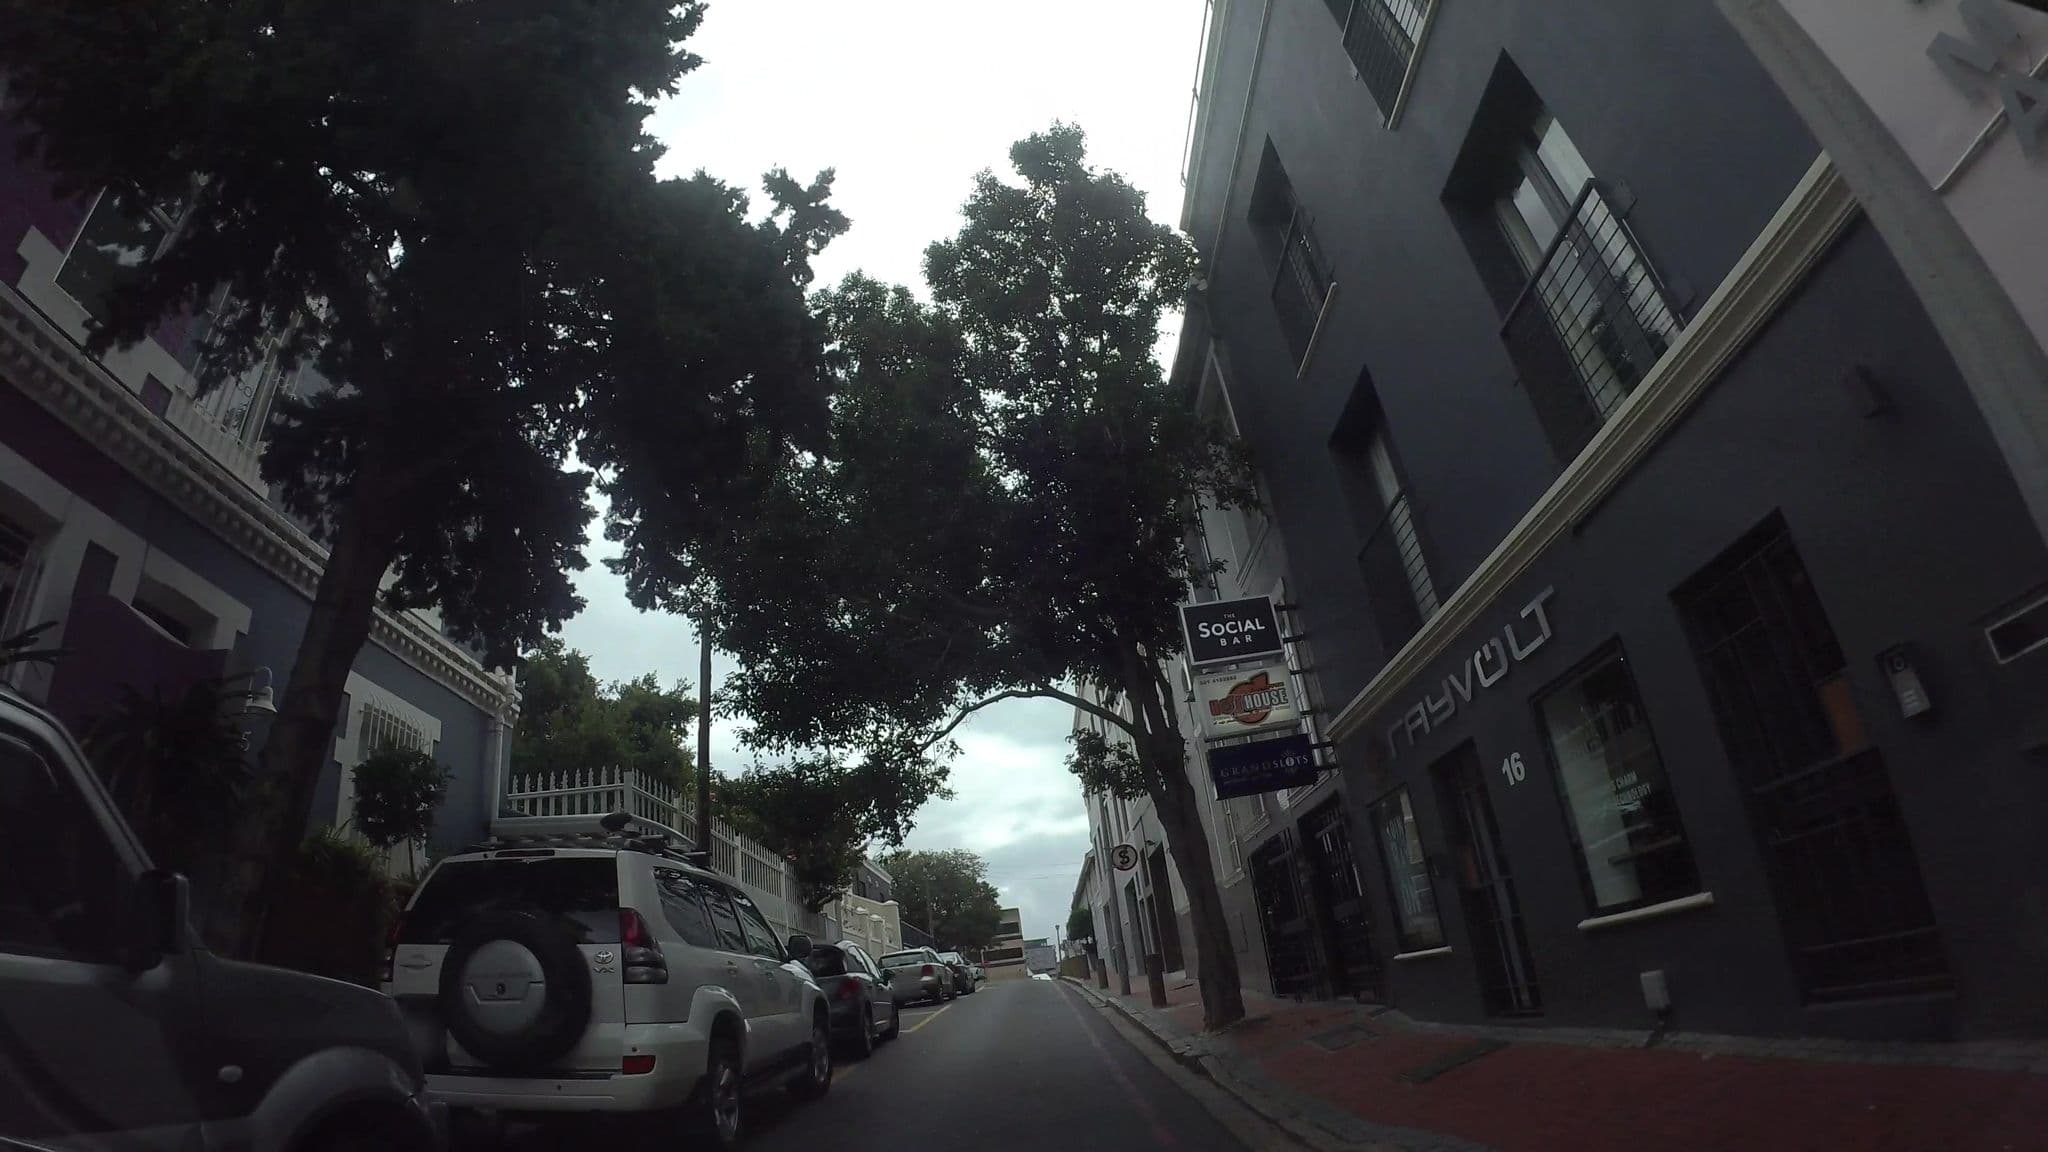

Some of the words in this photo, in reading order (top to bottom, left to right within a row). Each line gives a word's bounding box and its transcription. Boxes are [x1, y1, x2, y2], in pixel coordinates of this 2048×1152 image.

[1198, 618, 1266, 638] SOCIAL
[1219, 634, 1252, 647] BAR
[1243, 688, 1288, 712] HOUSE
[1502, 752, 1526, 786] 16
